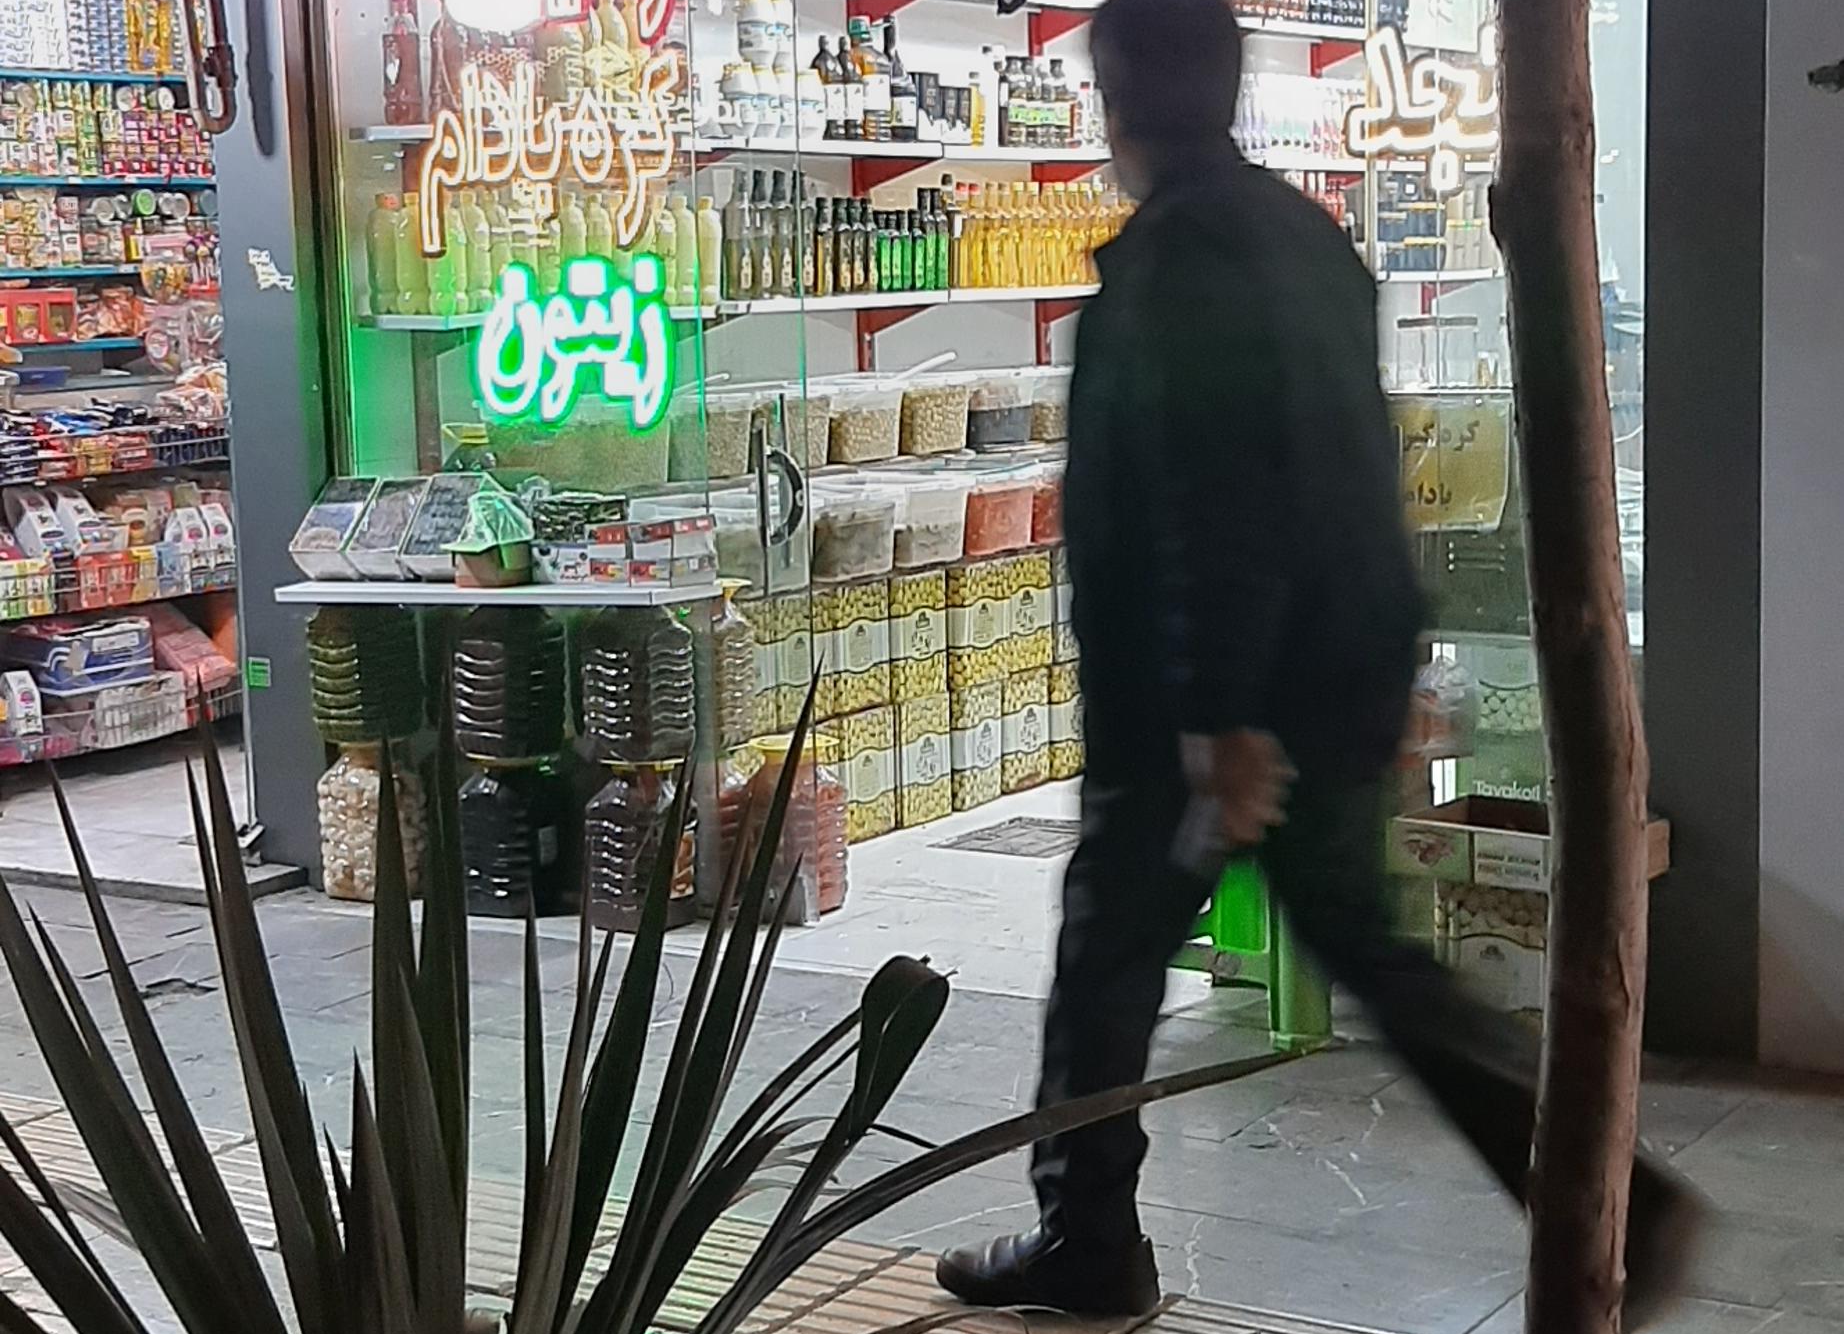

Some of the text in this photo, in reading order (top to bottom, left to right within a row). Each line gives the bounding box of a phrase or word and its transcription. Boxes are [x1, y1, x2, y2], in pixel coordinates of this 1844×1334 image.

[420, 53, 689, 257] کره بادام
[1344, 23, 1500, 195] نجد
[472, 252, 674, 433] زیتون
